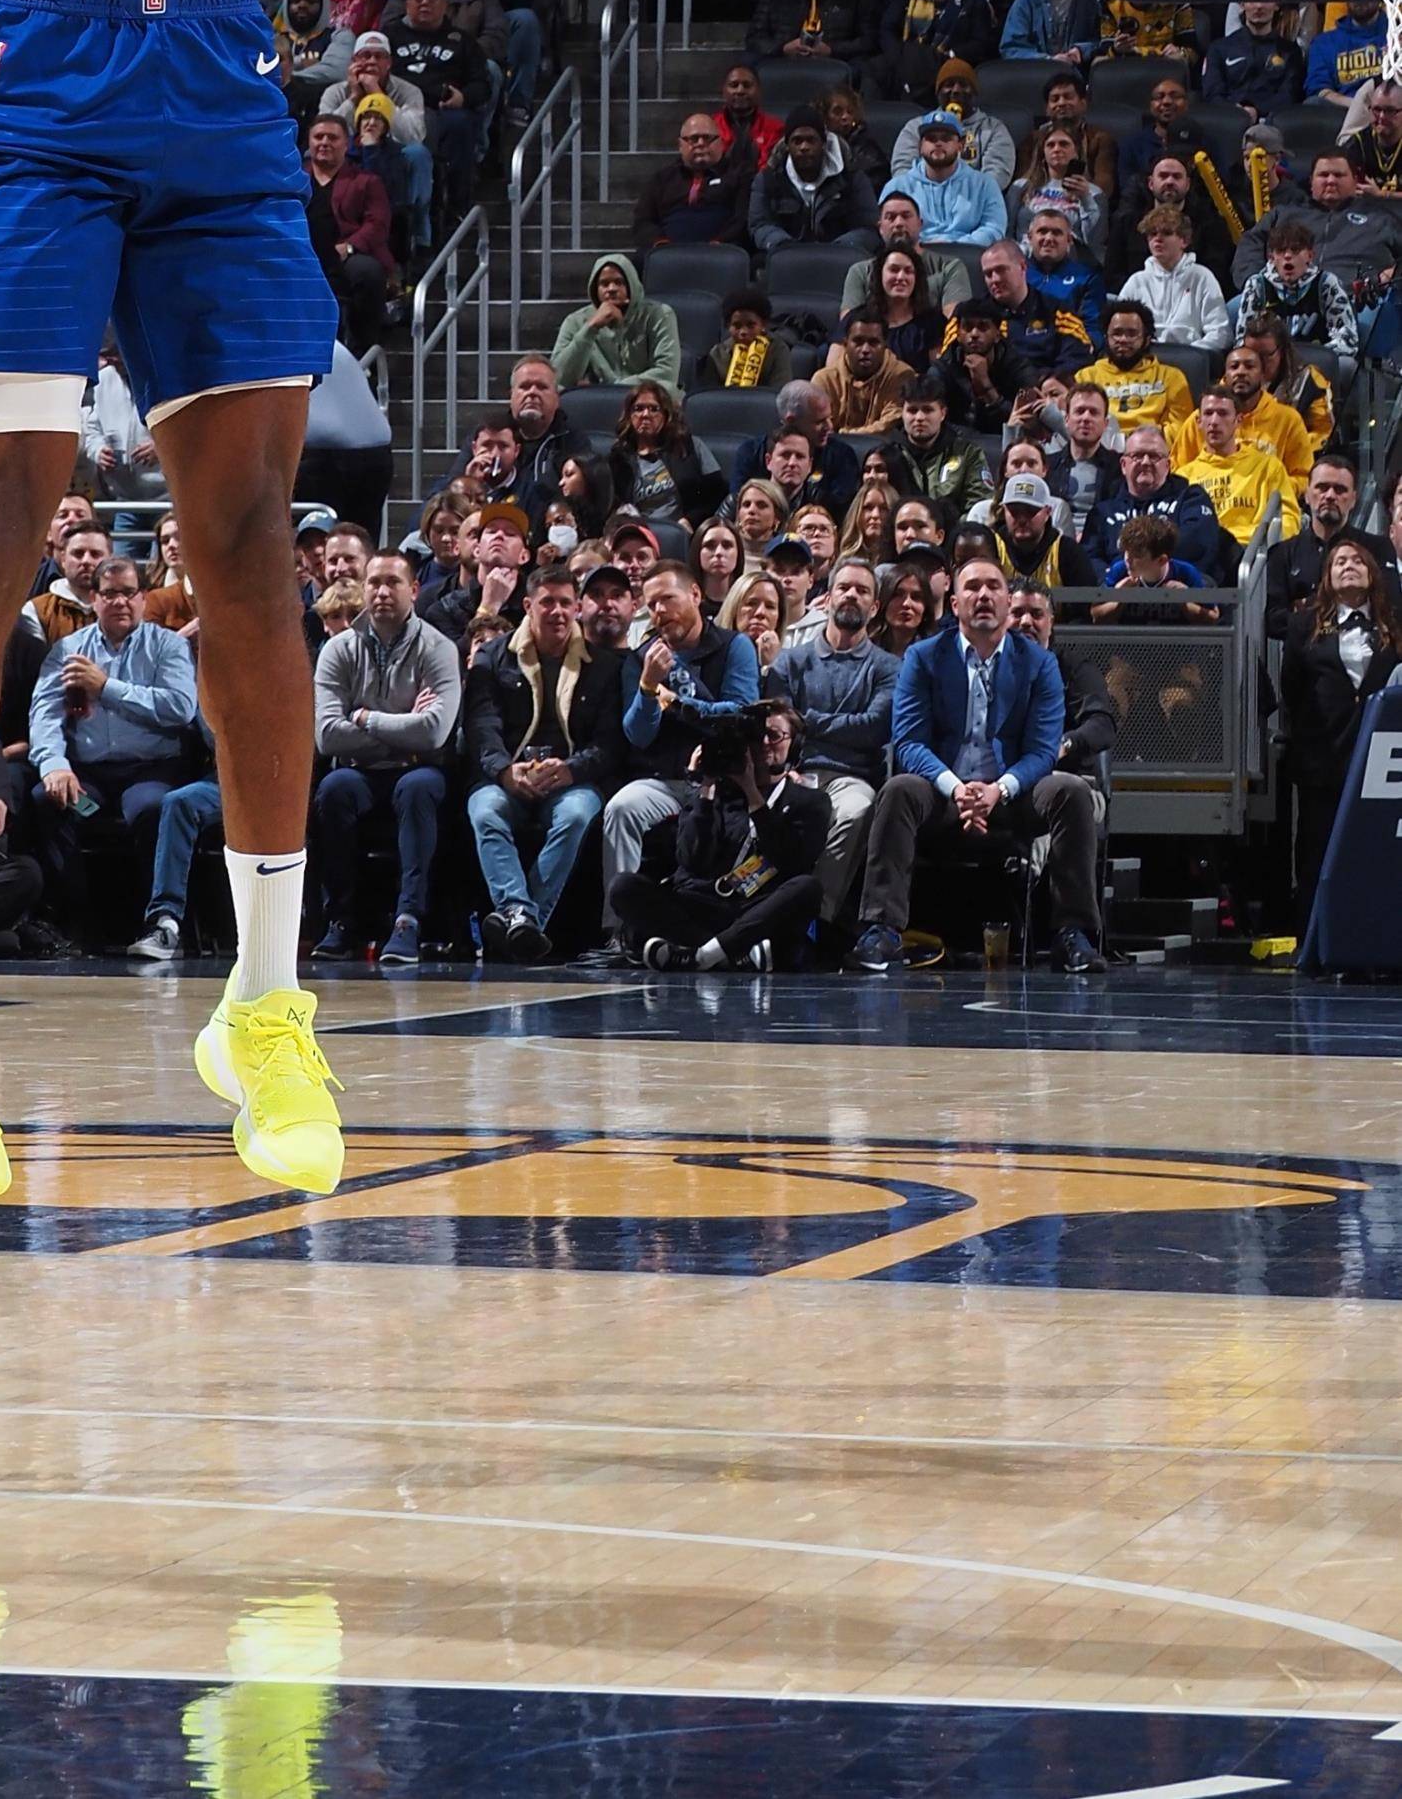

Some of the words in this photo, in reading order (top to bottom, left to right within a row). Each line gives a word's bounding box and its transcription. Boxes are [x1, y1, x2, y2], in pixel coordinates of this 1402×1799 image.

[1106, 378, 1164, 399] ACERS
[1208, 487, 1231, 500] CERS
[1214, 495, 1255, 510] KETBALL
